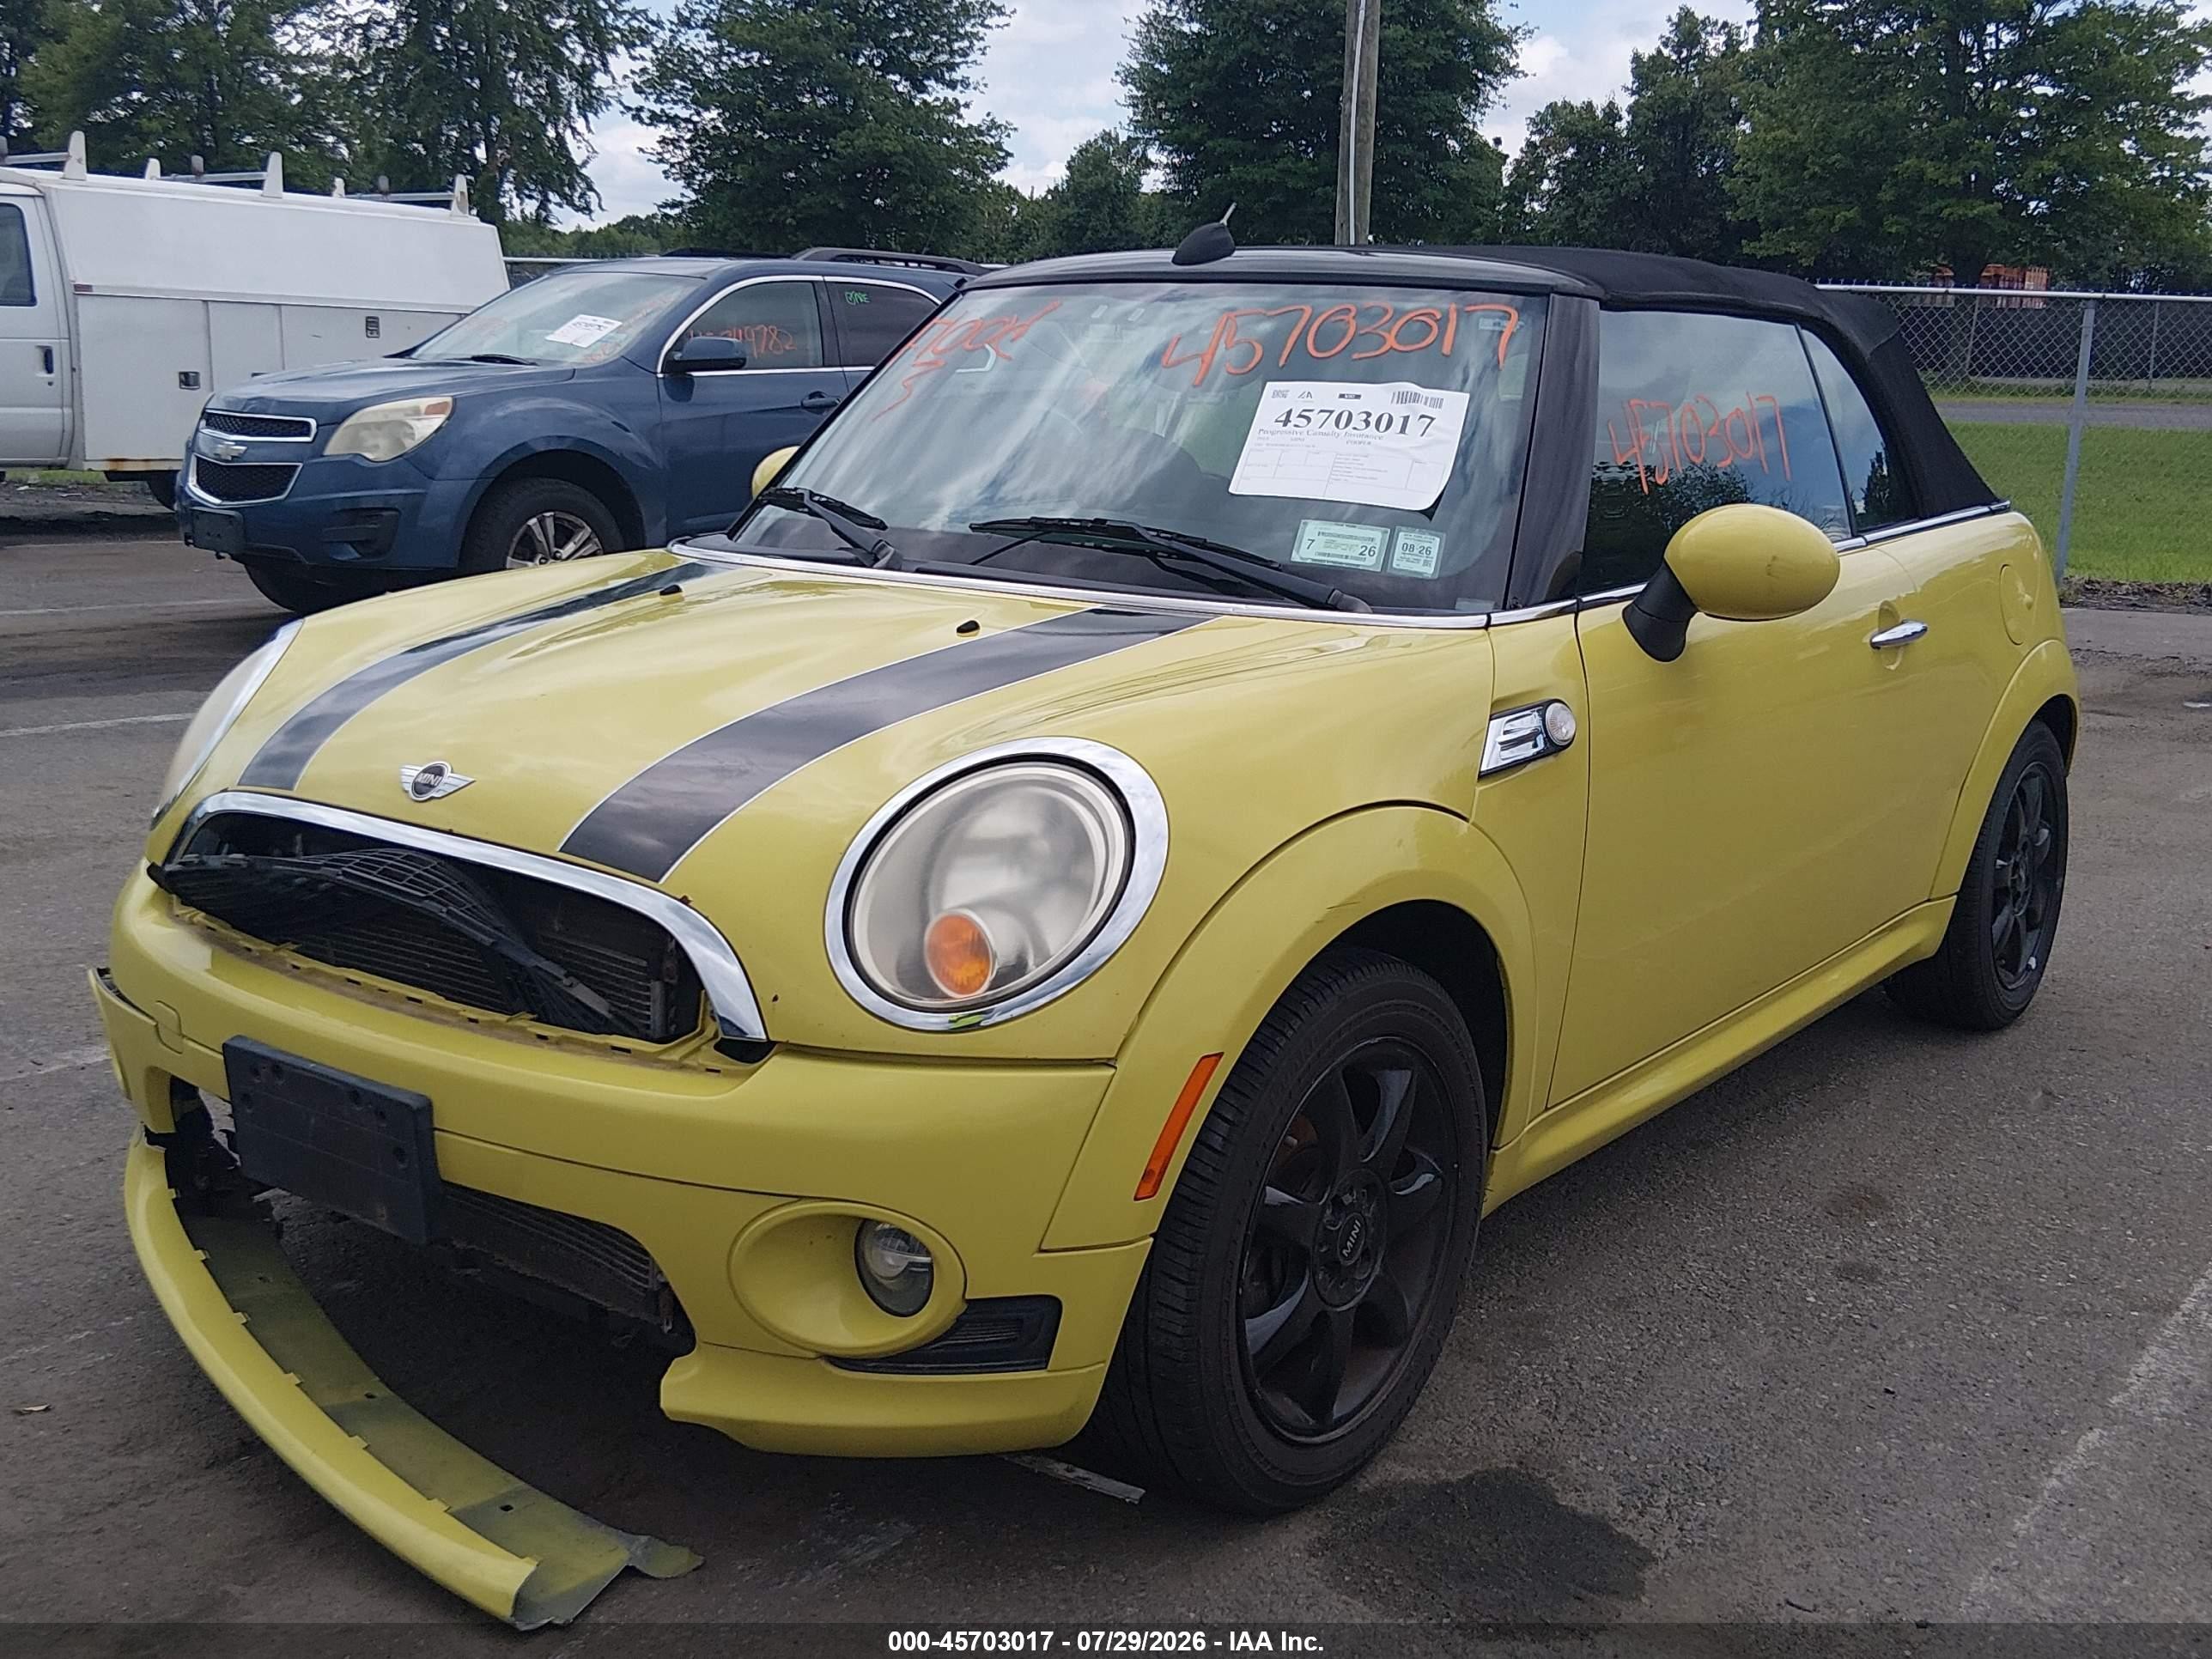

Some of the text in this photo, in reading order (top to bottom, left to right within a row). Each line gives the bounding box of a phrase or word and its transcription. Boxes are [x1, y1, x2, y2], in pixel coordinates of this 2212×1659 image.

[1161, 302, 1519, 386] 45703017
[1274, 407, 1437, 438] 45703017
[1306, 538, 1316, 550] 7
[1358, 545, 1376, 557] 26
[415, 773, 442, 786] MINI
[1342, 1219, 1361, 1257] MINI
